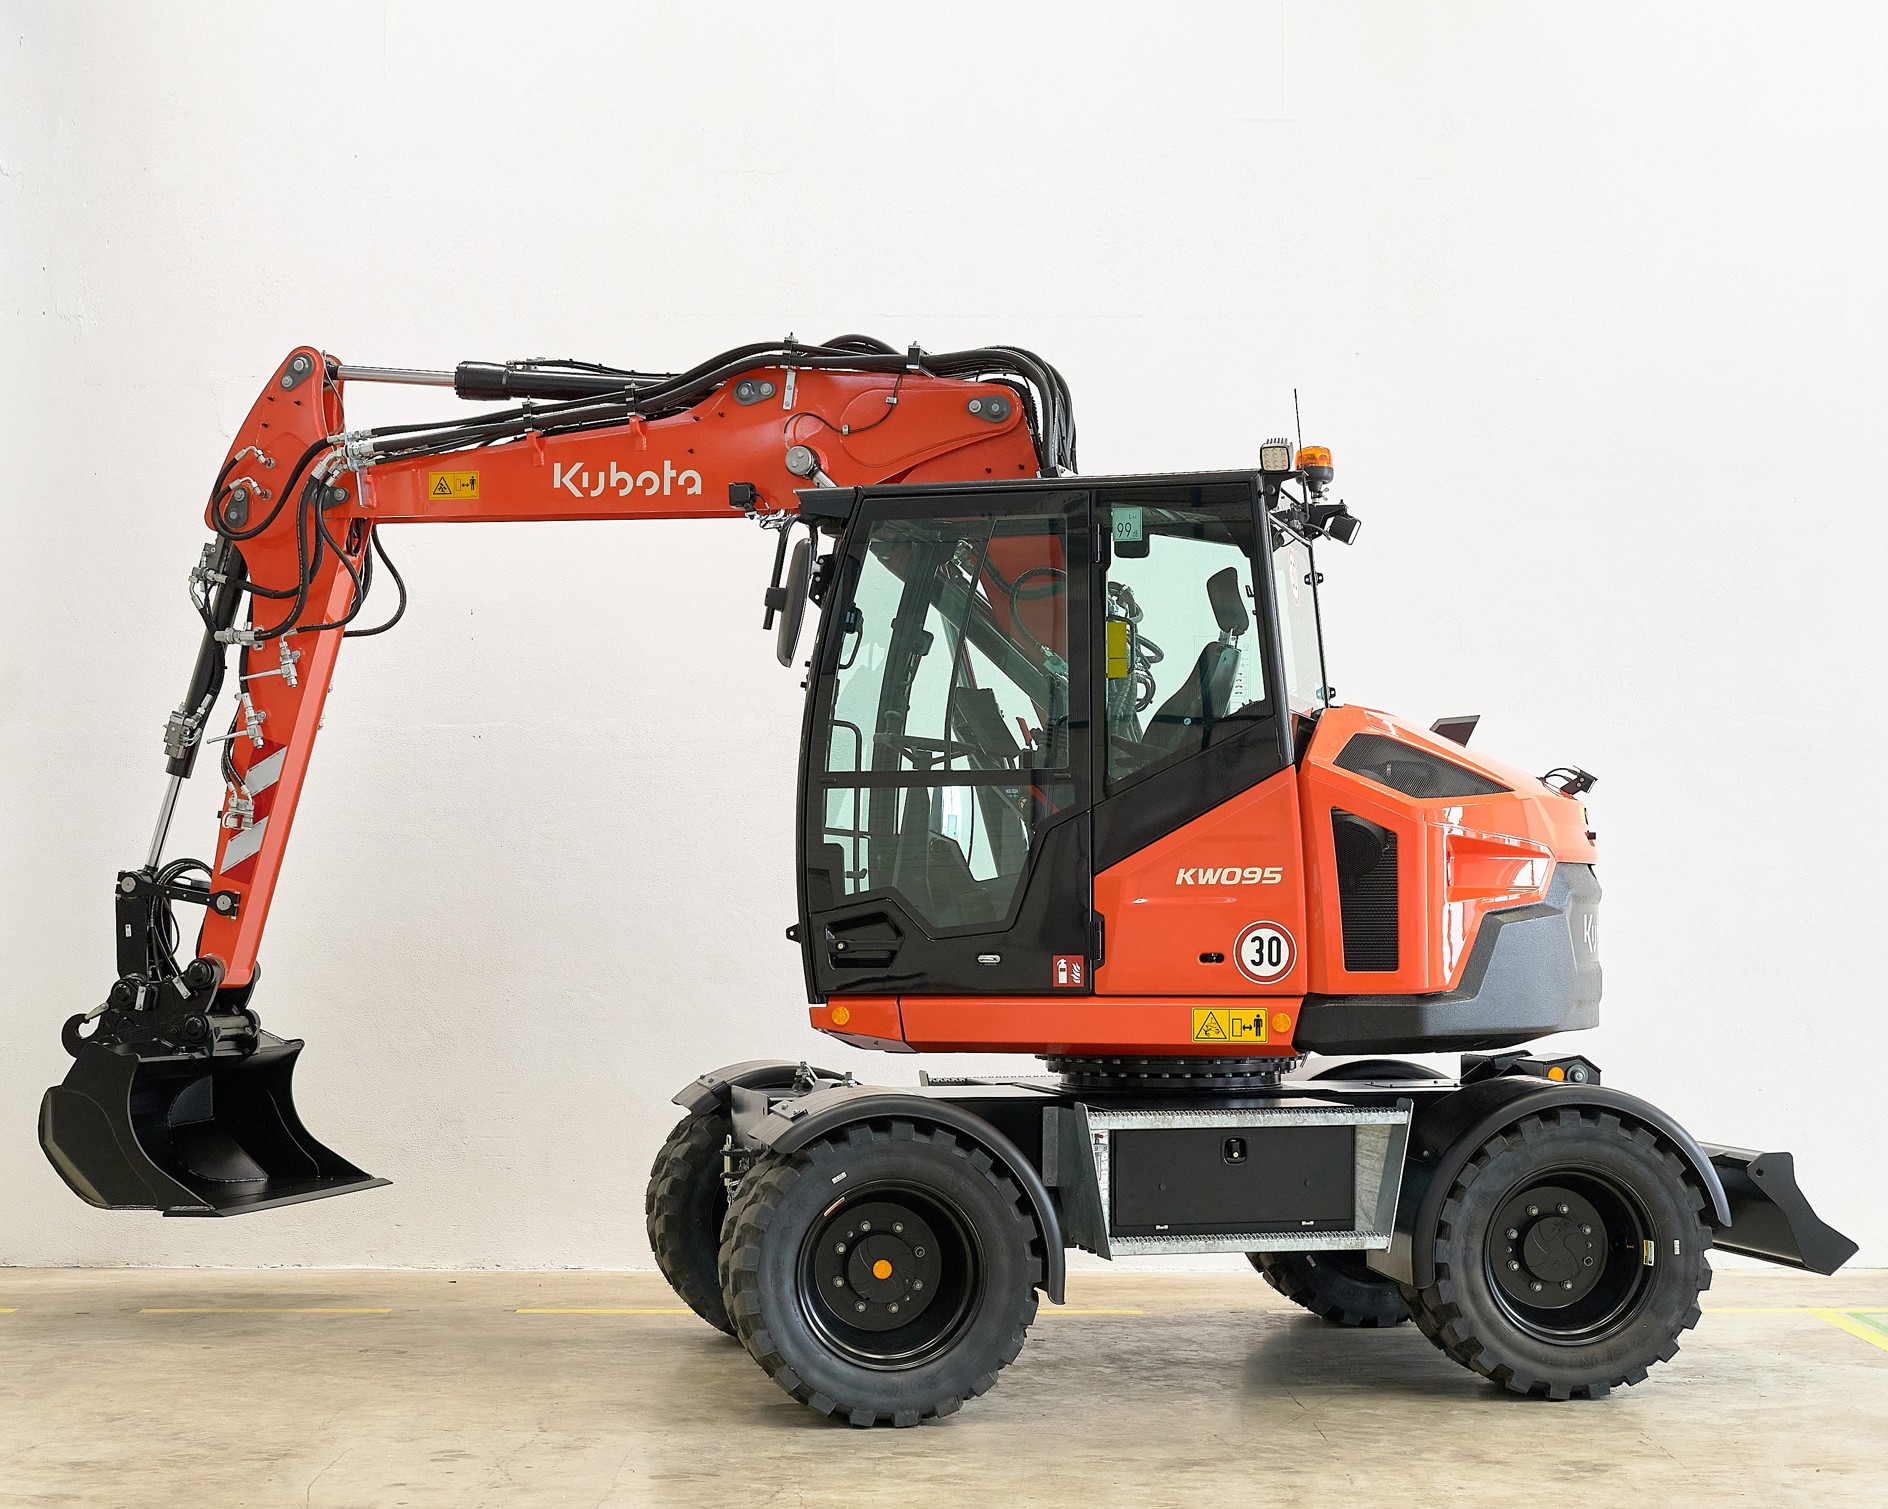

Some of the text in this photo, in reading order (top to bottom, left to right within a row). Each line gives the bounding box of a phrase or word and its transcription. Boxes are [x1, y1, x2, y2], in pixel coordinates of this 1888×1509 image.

[553, 460, 702, 498] Kubota
[1116, 522, 1132, 538] 99
[1175, 867, 1284, 885] KW095
[1583, 913, 1600, 954] Ku
[1250, 935, 1282, 967] 30
